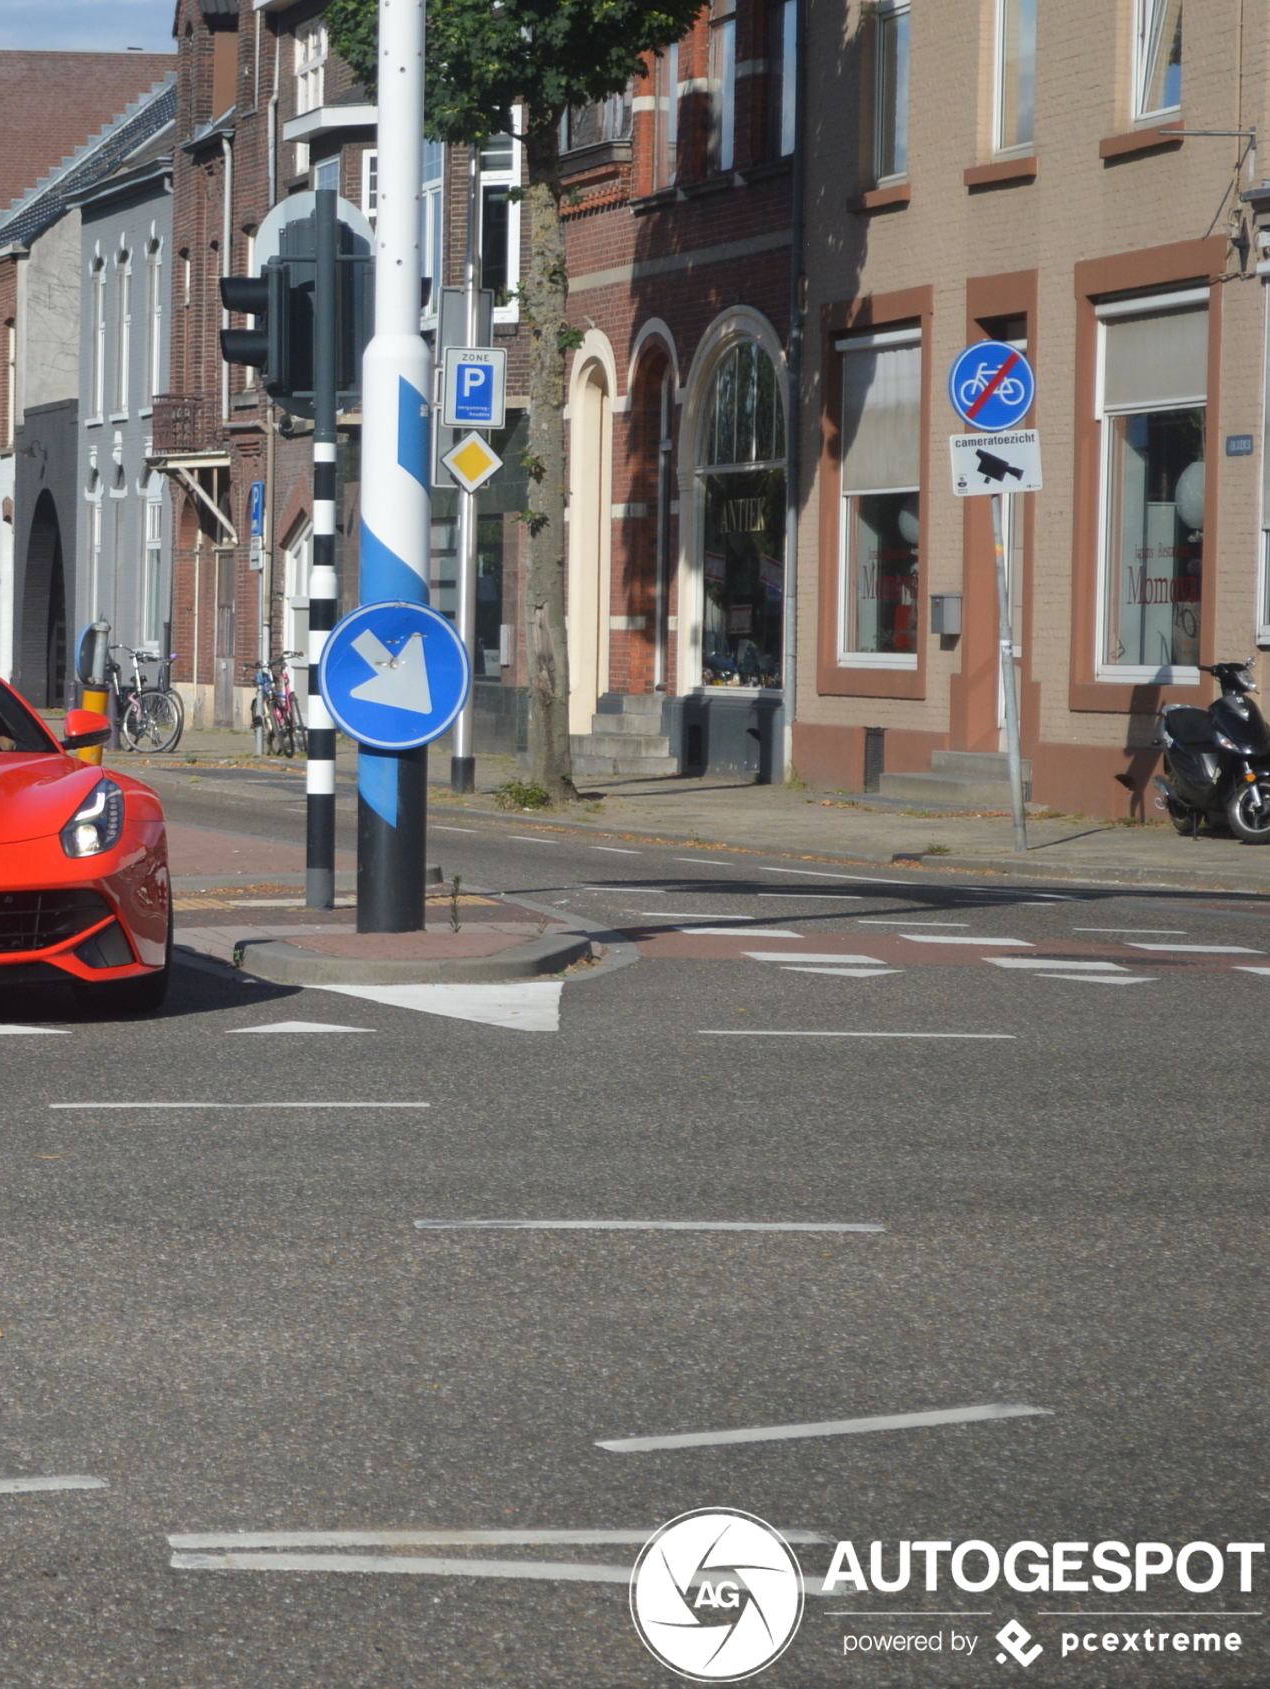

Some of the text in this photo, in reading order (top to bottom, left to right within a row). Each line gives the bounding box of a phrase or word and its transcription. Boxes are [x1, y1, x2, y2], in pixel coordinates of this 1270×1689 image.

[462, 353, 489, 361] ZONE
[463, 368, 485, 397] P
[955, 433, 1035, 448] cameratoezicht
[253, 486, 259, 513] P
[720, 497, 766, 533] ANTIEK
